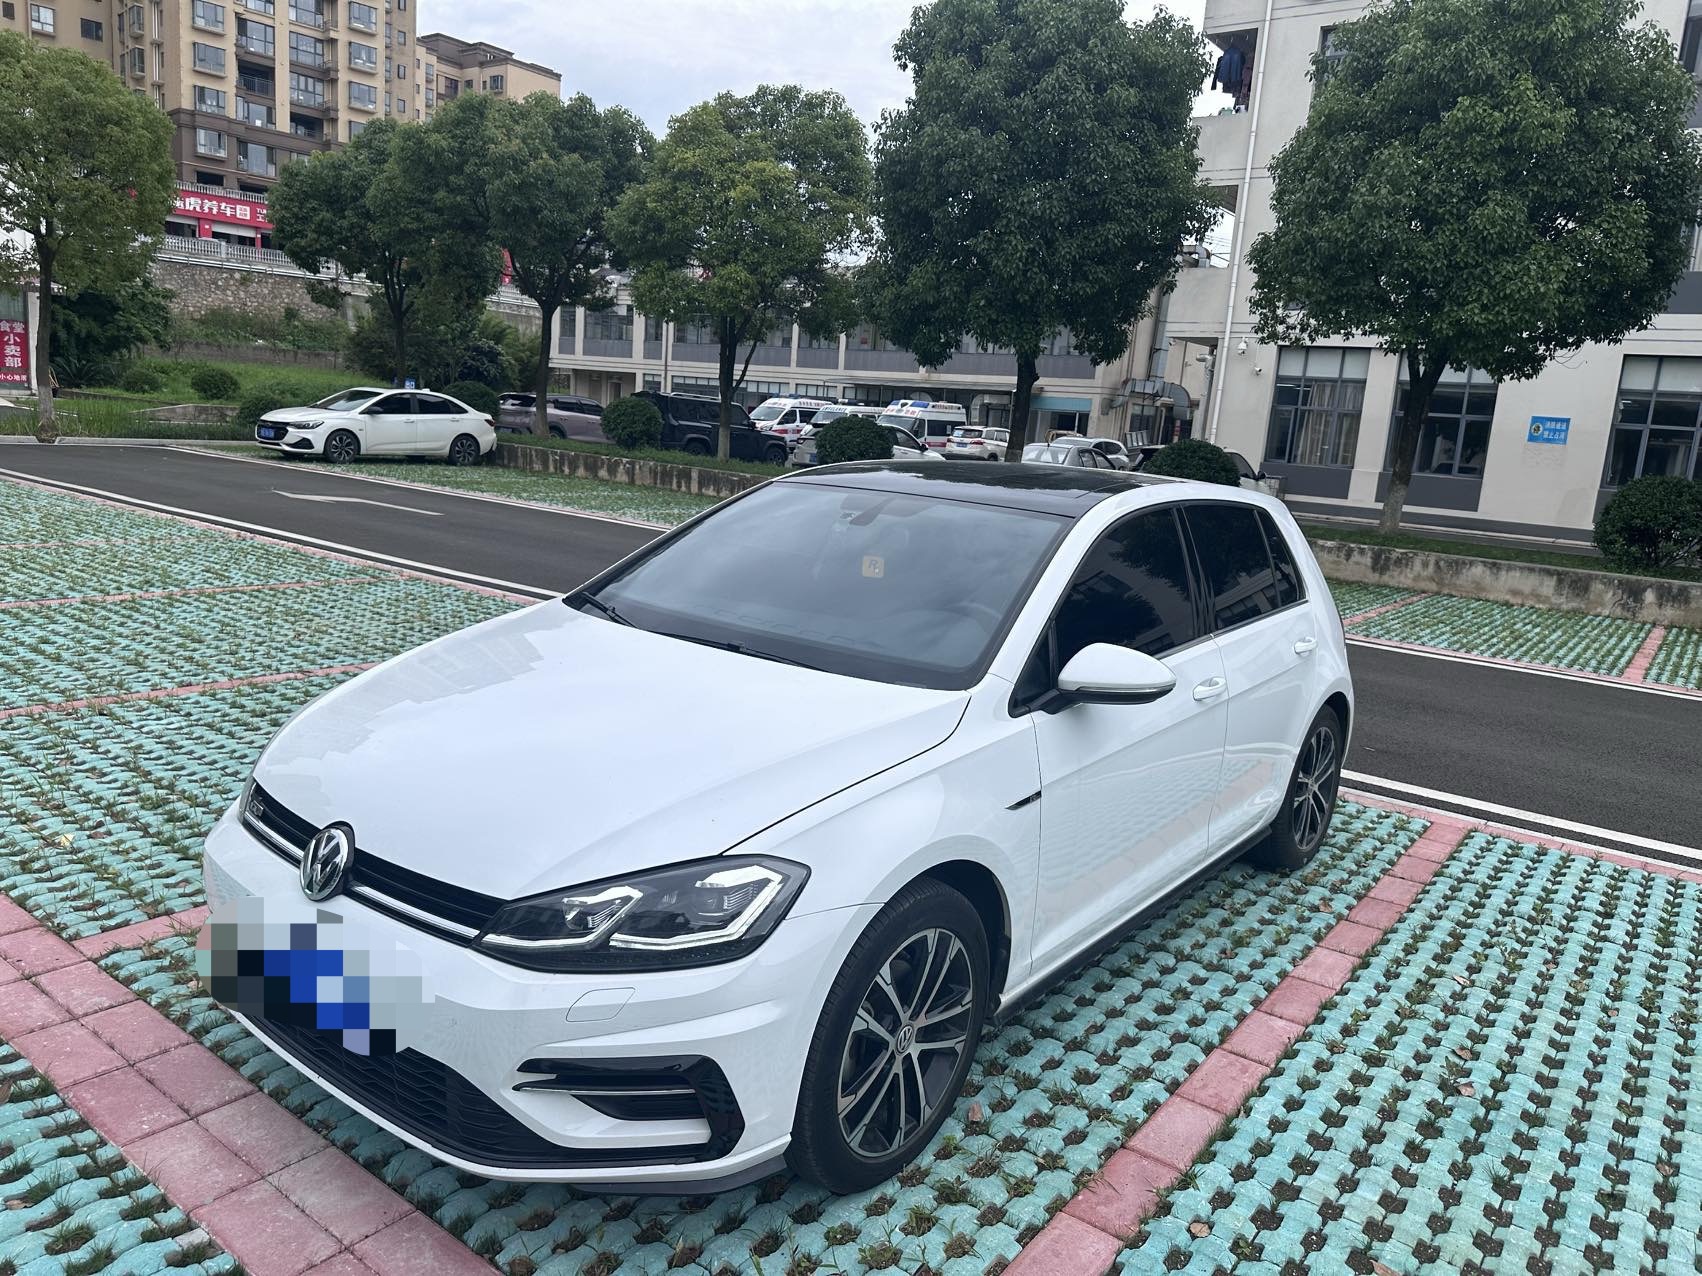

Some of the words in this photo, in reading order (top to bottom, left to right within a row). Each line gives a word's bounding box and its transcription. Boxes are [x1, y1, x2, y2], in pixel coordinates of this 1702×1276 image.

[256, 214, 268, 223] 工
[0, 320, 25, 333] 食堂
[3, 333, 22, 368] 小卖部
